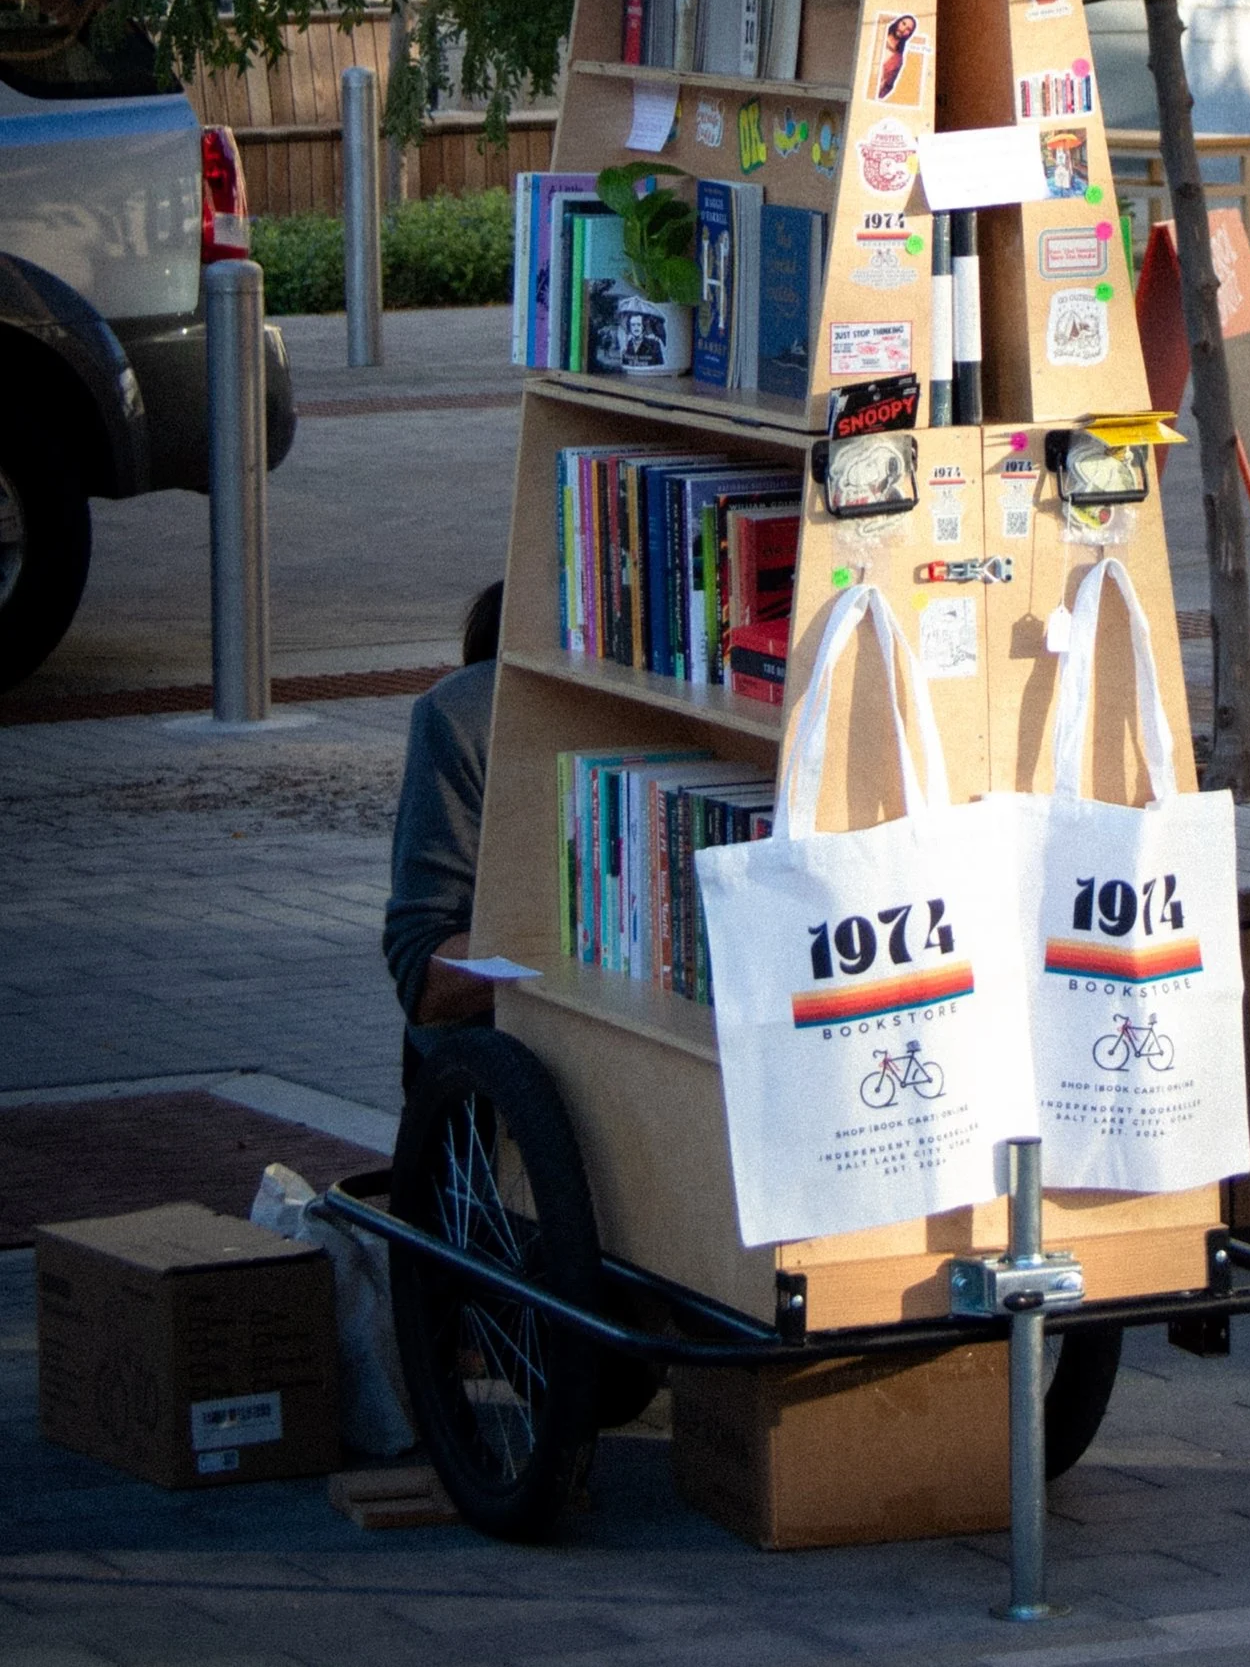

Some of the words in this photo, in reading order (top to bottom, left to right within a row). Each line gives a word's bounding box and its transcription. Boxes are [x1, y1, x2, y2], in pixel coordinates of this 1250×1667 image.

[864, 212, 905, 229] 1974
[834, 330, 851, 340] JUST
[853, 329, 870, 339] STOP
[873, 325, 905, 335] THINKING
[838, 394, 916, 437] SNOOPY
[933, 466, 961, 479] 1974
[1004, 460, 1033, 472] 1974
[808, 898, 955, 979] 1974
[1069, 978, 1192, 998] BOOKSTORE
[822, 1002, 957, 1040] BOOKSTORE
[1061, 1081, 1090, 1090] SHOP
[1041, 1100, 1133, 1114] INDEPENDENT
[1140, 1099, 1201, 1115] BOOKSELLER
[1056, 1113, 1086, 1123] SALT
[1093, 1116, 1125, 1125] LAKE
[835, 1126, 865, 1139] SHOP
[1136, 1130, 1165, 1138] 2024
[819, 1140, 911, 1162] INDEPENDENT
[918, 1122, 979, 1146] BOOKSELLER
[837, 1159, 867, 1172] SALT
[875, 1153, 906, 1165] LAKE
